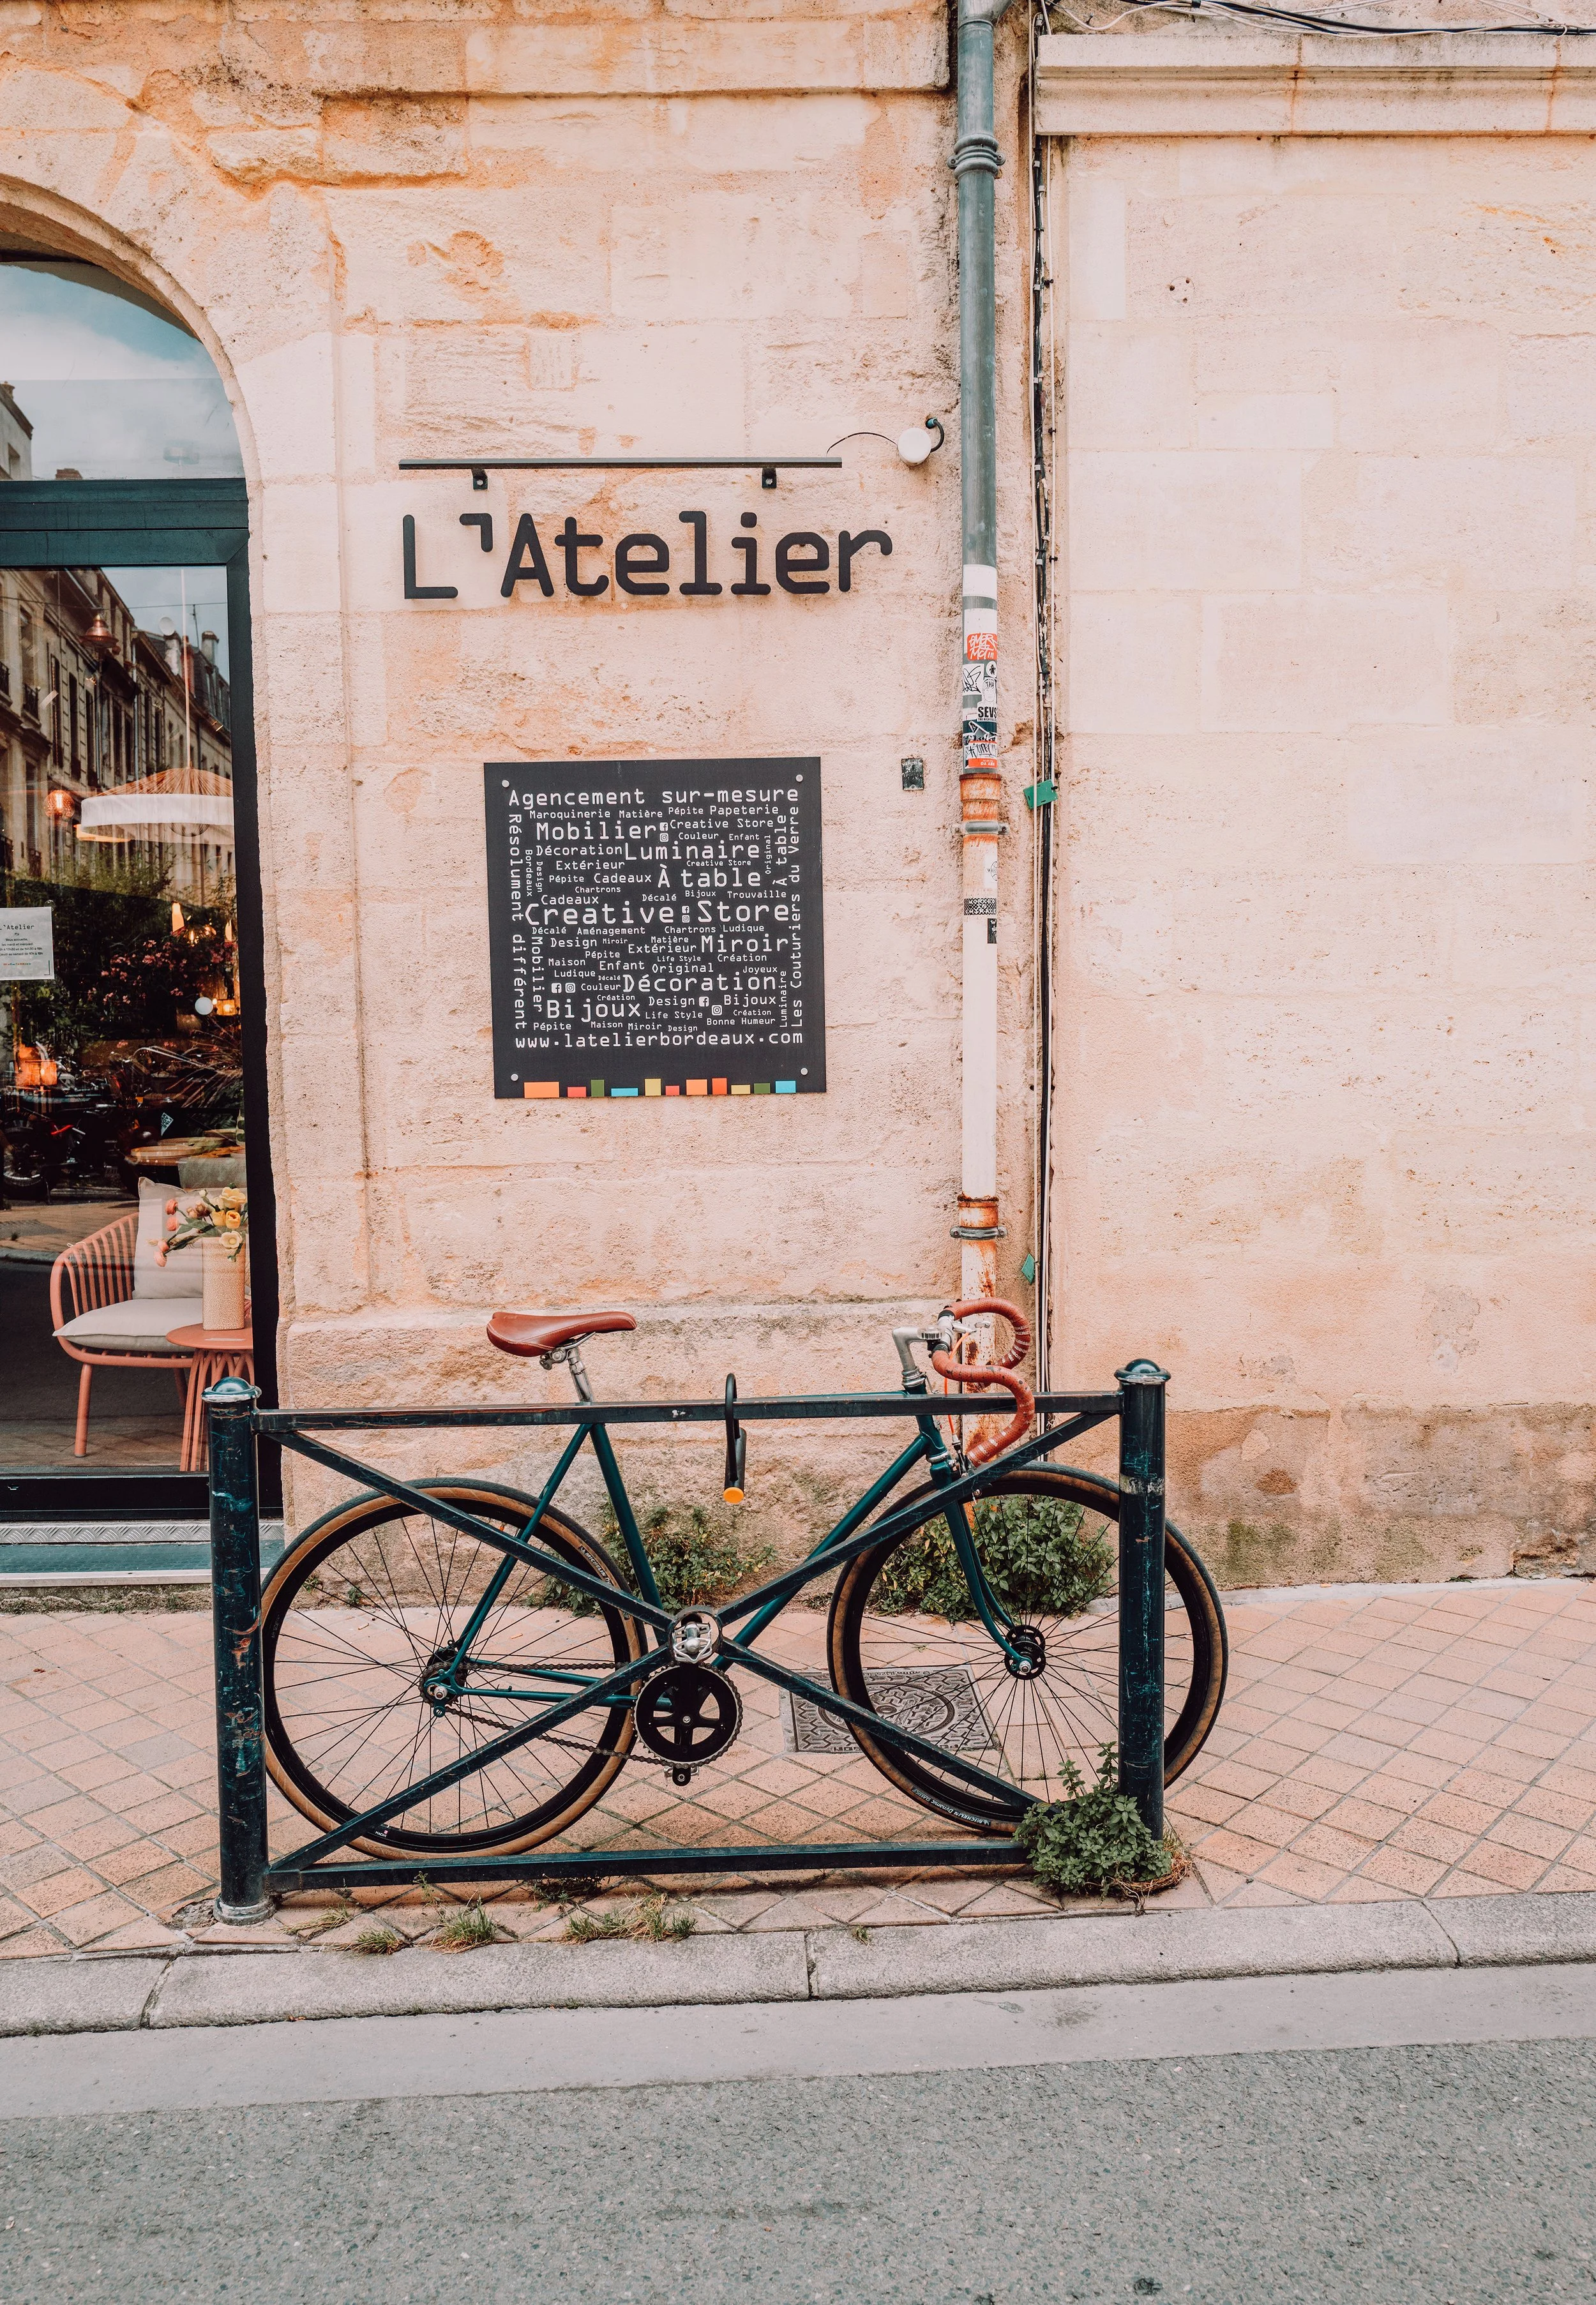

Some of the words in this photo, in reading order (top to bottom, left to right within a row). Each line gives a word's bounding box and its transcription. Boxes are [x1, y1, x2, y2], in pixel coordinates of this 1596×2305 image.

[403, 510, 893, 599] L'Atelier
[508, 788, 645, 810] Agencement
[662, 788, 799, 804] sur-mesure
[529, 808, 611, 821] Maroquinerie
[619, 809, 663, 818] Matière
[668, 806, 704, 816] Pépite
[709, 804, 779, 818] Papeterie
[670, 818, 729, 829] Creative
[737, 818, 774, 828] Store
[787, 806, 799, 854] Verre
[536, 820, 657, 841] Mobilier
[678, 832, 719, 840] Couleur
[774, 815, 787, 866] table
[536, 843, 622, 856] Décoration
[624, 839, 760, 860] Luminaire
[764, 834, 772, 875] Original
[508, 814, 524, 922] Résolument
[556, 859, 625, 871] Extérieur
[525, 849, 534, 897] Bordeaux
[535, 861, 544, 893] Design
[549, 874, 585, 885] Pépite
[593, 872, 652, 883] Cadeaux
[658, 863, 670, 889] À
[680, 867, 761, 888] table
[788, 864, 800, 883] du
[772, 877, 788, 887] À
[541, 894, 599, 905] Cadeaux
[642, 893, 677, 902] Décalé
[685, 889, 716, 899] Bijoux
[726, 890, 787, 899] Trouvaille
[525, 900, 674, 924] Creative
[697, 900, 789, 922] Store
[532, 926, 567, 935] Décalé
[576, 926, 646, 936] Aménagement
[664, 926, 716, 934] Chartrons
[723, 924, 765, 934] Ludique
[550, 936, 598, 949] Design
[651, 935, 689, 943] Matière
[701, 934, 788, 953] Miroir
[788, 894, 802, 989] Couturiers
[585, 950, 621, 960] Pépite
[628, 943, 697, 954] Extérieur
[548, 957, 586, 966] Maison
[679, 955, 701, 963] Style
[717, 952, 767, 963] Création
[599, 960, 645, 971] Enfant
[652, 962, 714, 975] Original
[742, 965, 778, 975] Joyeux
[531, 936, 545, 1012] Mobilier
[554, 969, 596, 979] Ludique
[512, 934, 527, 1030] différent
[580, 982, 621, 991] Couleur
[622, 971, 776, 993] Décoration
[648, 995, 695, 1008] Design
[723, 993, 776, 1008] Bijoux
[778, 970, 788, 1028] Luminaire
[546, 998, 641, 1025] Bijoux
[645, 1011, 668, 1019] Life
[674, 1010, 703, 1020] Style
[790, 1000, 802, 1027] Les
[533, 1021, 571, 1032] Pépite
[628, 1022, 662, 1030] Miroir
[706, 1017, 735, 1026] Bonne
[741, 1017, 776, 1025] Humeur
[668, 1024, 698, 1033] Design
[515, 1031, 803, 1049] www.latelierbordeaux.com
[931, 1799, 954, 1813] Dynamic
[954, 1812, 984, 1824] MICHELIN
